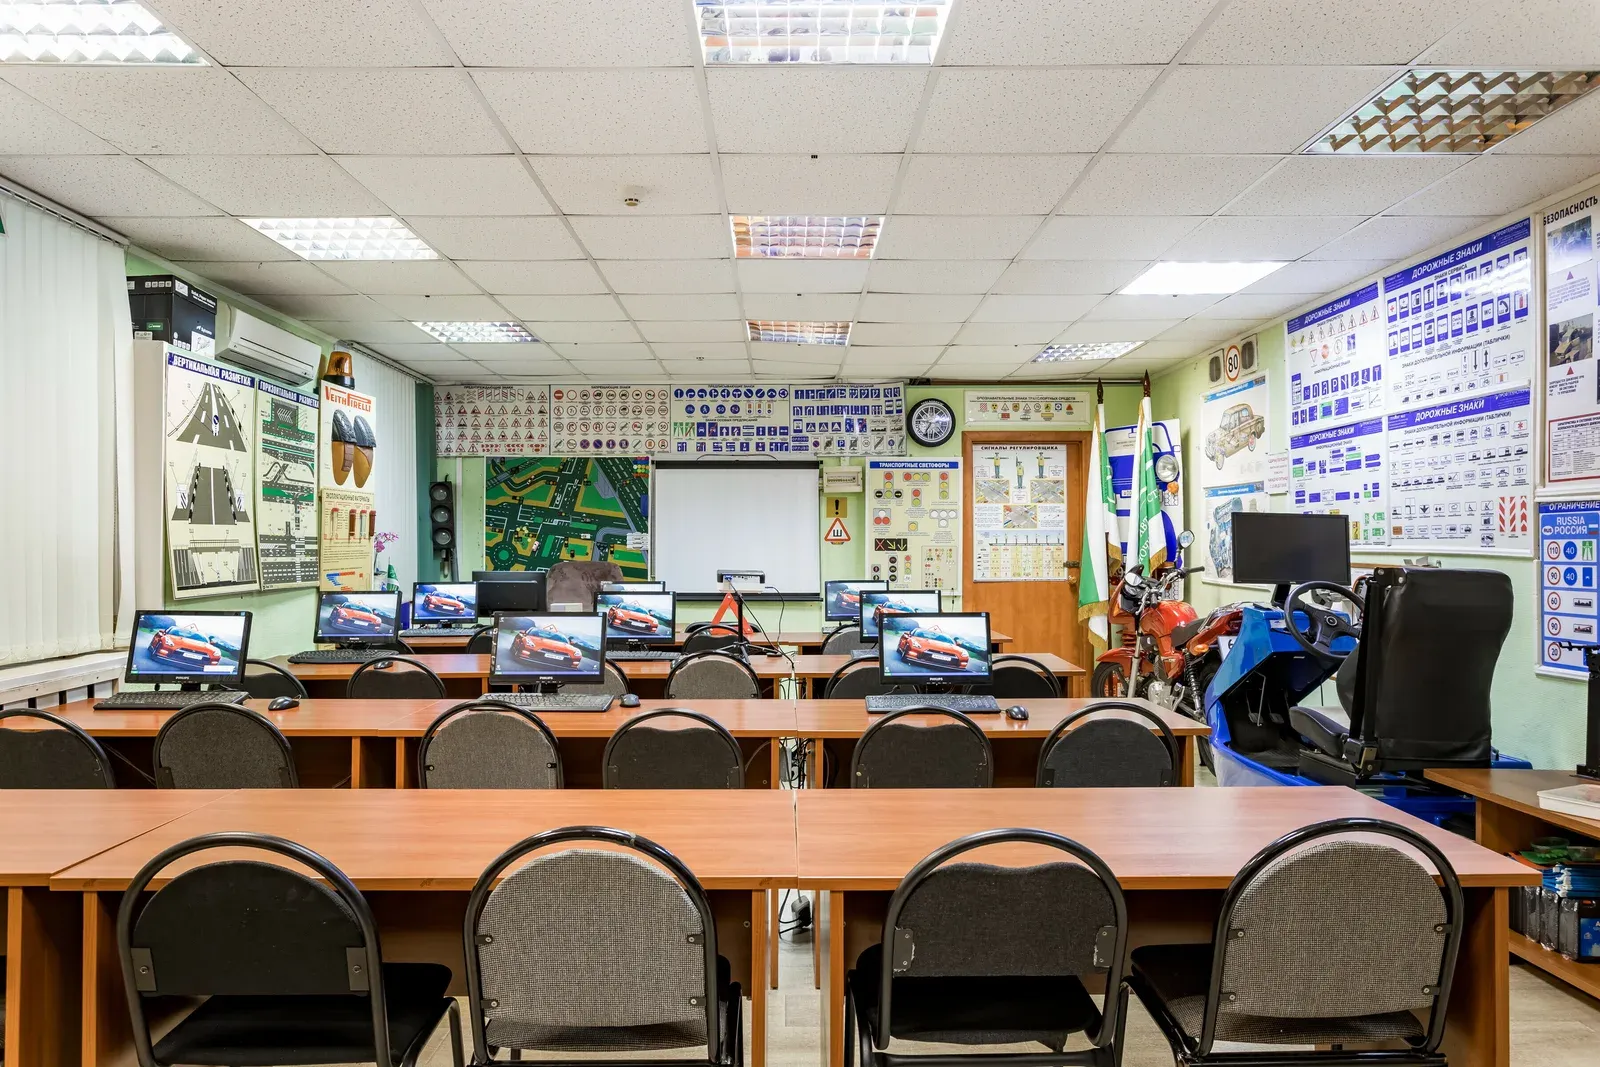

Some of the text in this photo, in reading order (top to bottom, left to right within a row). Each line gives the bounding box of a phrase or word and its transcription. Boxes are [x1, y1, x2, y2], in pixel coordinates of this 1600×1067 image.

[1543, 196, 1598, 226] БЕЗОПАСНОСТЬ
[1412, 242, 1482, 280] ДОРОЖНЫЕ ЗНАКИ
[1448, 264, 1467, 276] СЕРВИСА
[1304, 298, 1350, 324] ДОРОЖНЫЕ ЗНАКИ
[1414, 351, 1451, 366] ДОПОЛНИТЕЛЬНОЙ
[1452, 343, 1482, 357] ИНФОРМАЦИИ
[1483, 334, 1510, 346] (ТАБЛИЧКИ)
[174, 356, 220, 378] ВЕРТИКАЛЬНАЯ
[221, 369, 252, 386] РАЗМЕТКА
[1228, 354, 1238, 372] 80
[260, 381, 319, 408] ГОРИЗОНТАЛЬНАЯ РАЗМЕТК
[325, 386, 371, 412] VEITH PIRELLI
[1415, 406, 1457, 422] ДОРОЖНЫЕ
[1458, 400, 1484, 413] ЗНАКИ
[1416, 421, 1453, 433] ДОПОЛНИТЕЛЬНОЙ
[1454, 417, 1484, 426] ИНФОРМАЦИИ
[1485, 411, 1511, 421] (ТАБЛИЧКИ)
[1309, 430, 1337, 443] ДОРОЖНЫЕ
[1337, 426, 1354, 438] ЗНАКИ
[1549, 501, 1600, 511] ОГРАНИЧЕНИЕ
[1554, 526, 1587, 534] РОССИЯ
[1556, 516, 1585, 525] RUSSIA
[1566, 572, 1575, 580] 40
[1551, 623, 1558, 631] 90
